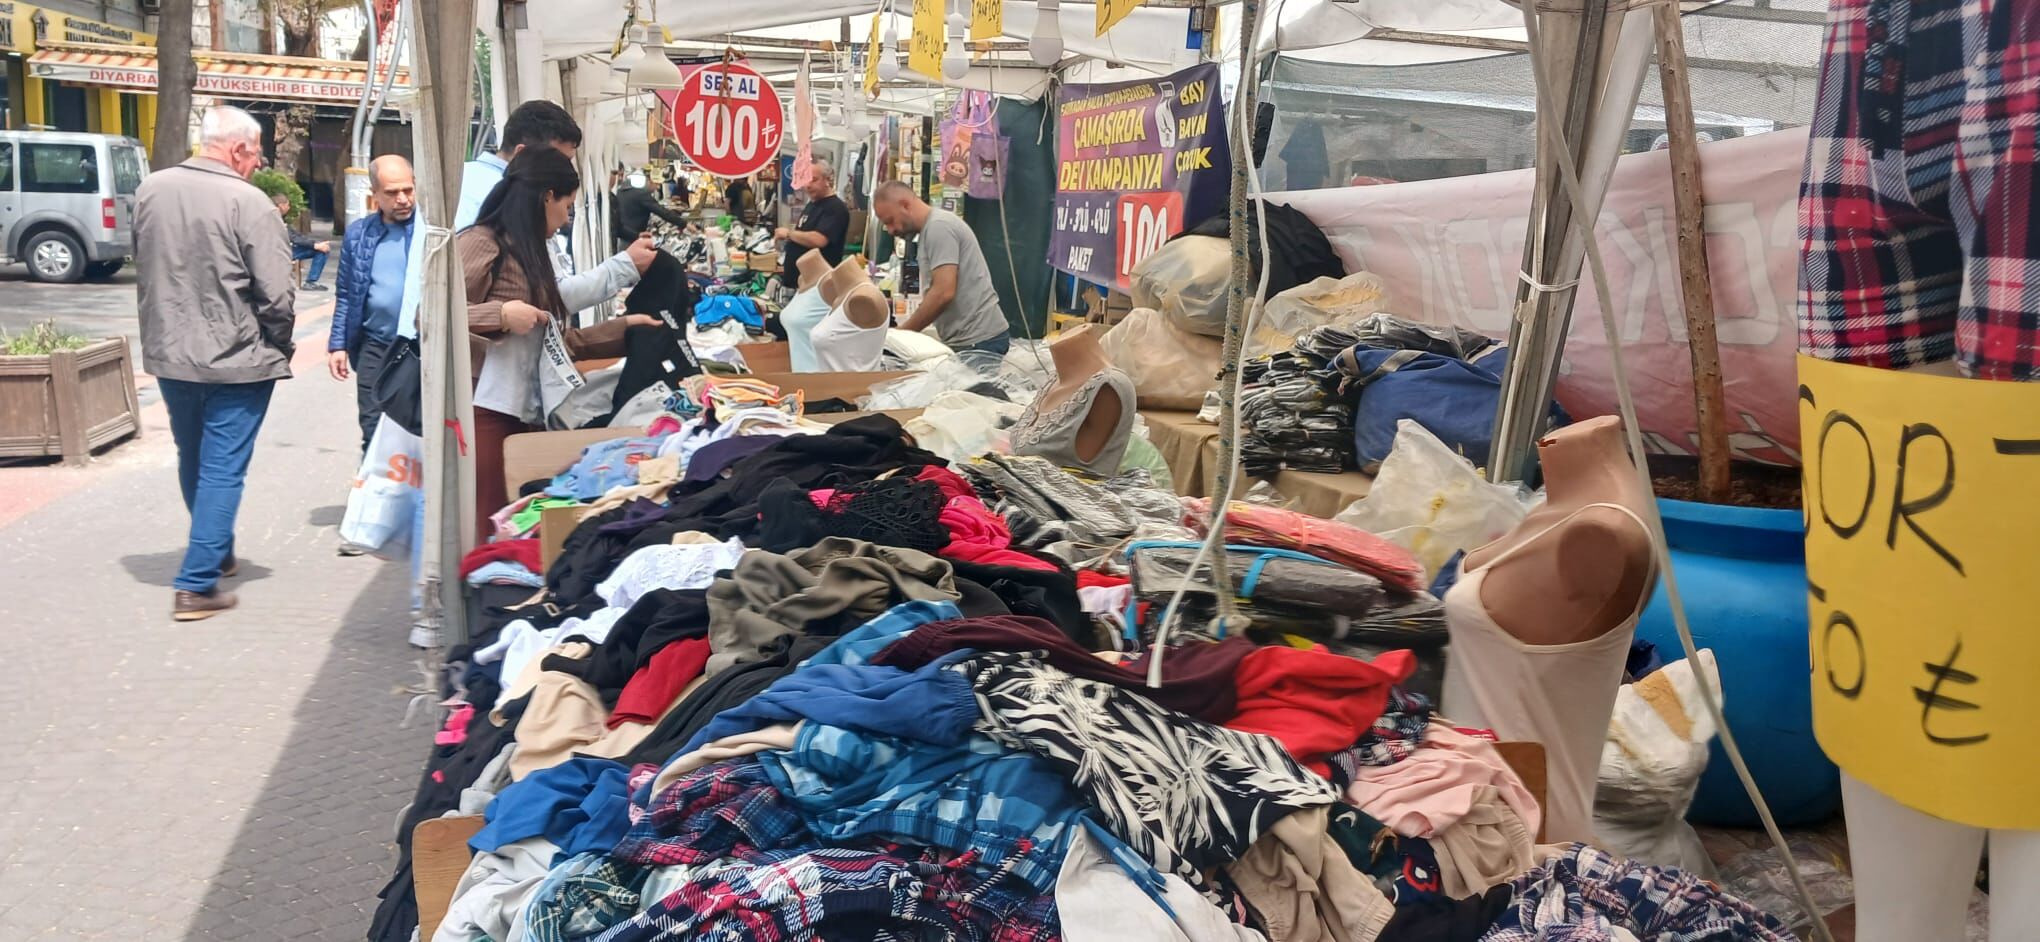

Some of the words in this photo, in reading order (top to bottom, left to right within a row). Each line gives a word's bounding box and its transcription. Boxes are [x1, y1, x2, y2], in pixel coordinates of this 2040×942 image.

[89, 69, 158, 84] DİYARBA
[197, 75, 286, 94] ÜYÜKŞEHİR
[291, 83, 381, 98] BELEDİYE
[738, 78, 757, 94] AL
[1179, 80, 1205, 106] BAY
[1074, 106, 1147, 156] ÇAMAŞIRDA
[1085, 152, 1164, 190] KAMPANYA
[1067, 245, 1094, 273] PAKET
[543, 337, 565, 367] BARON
